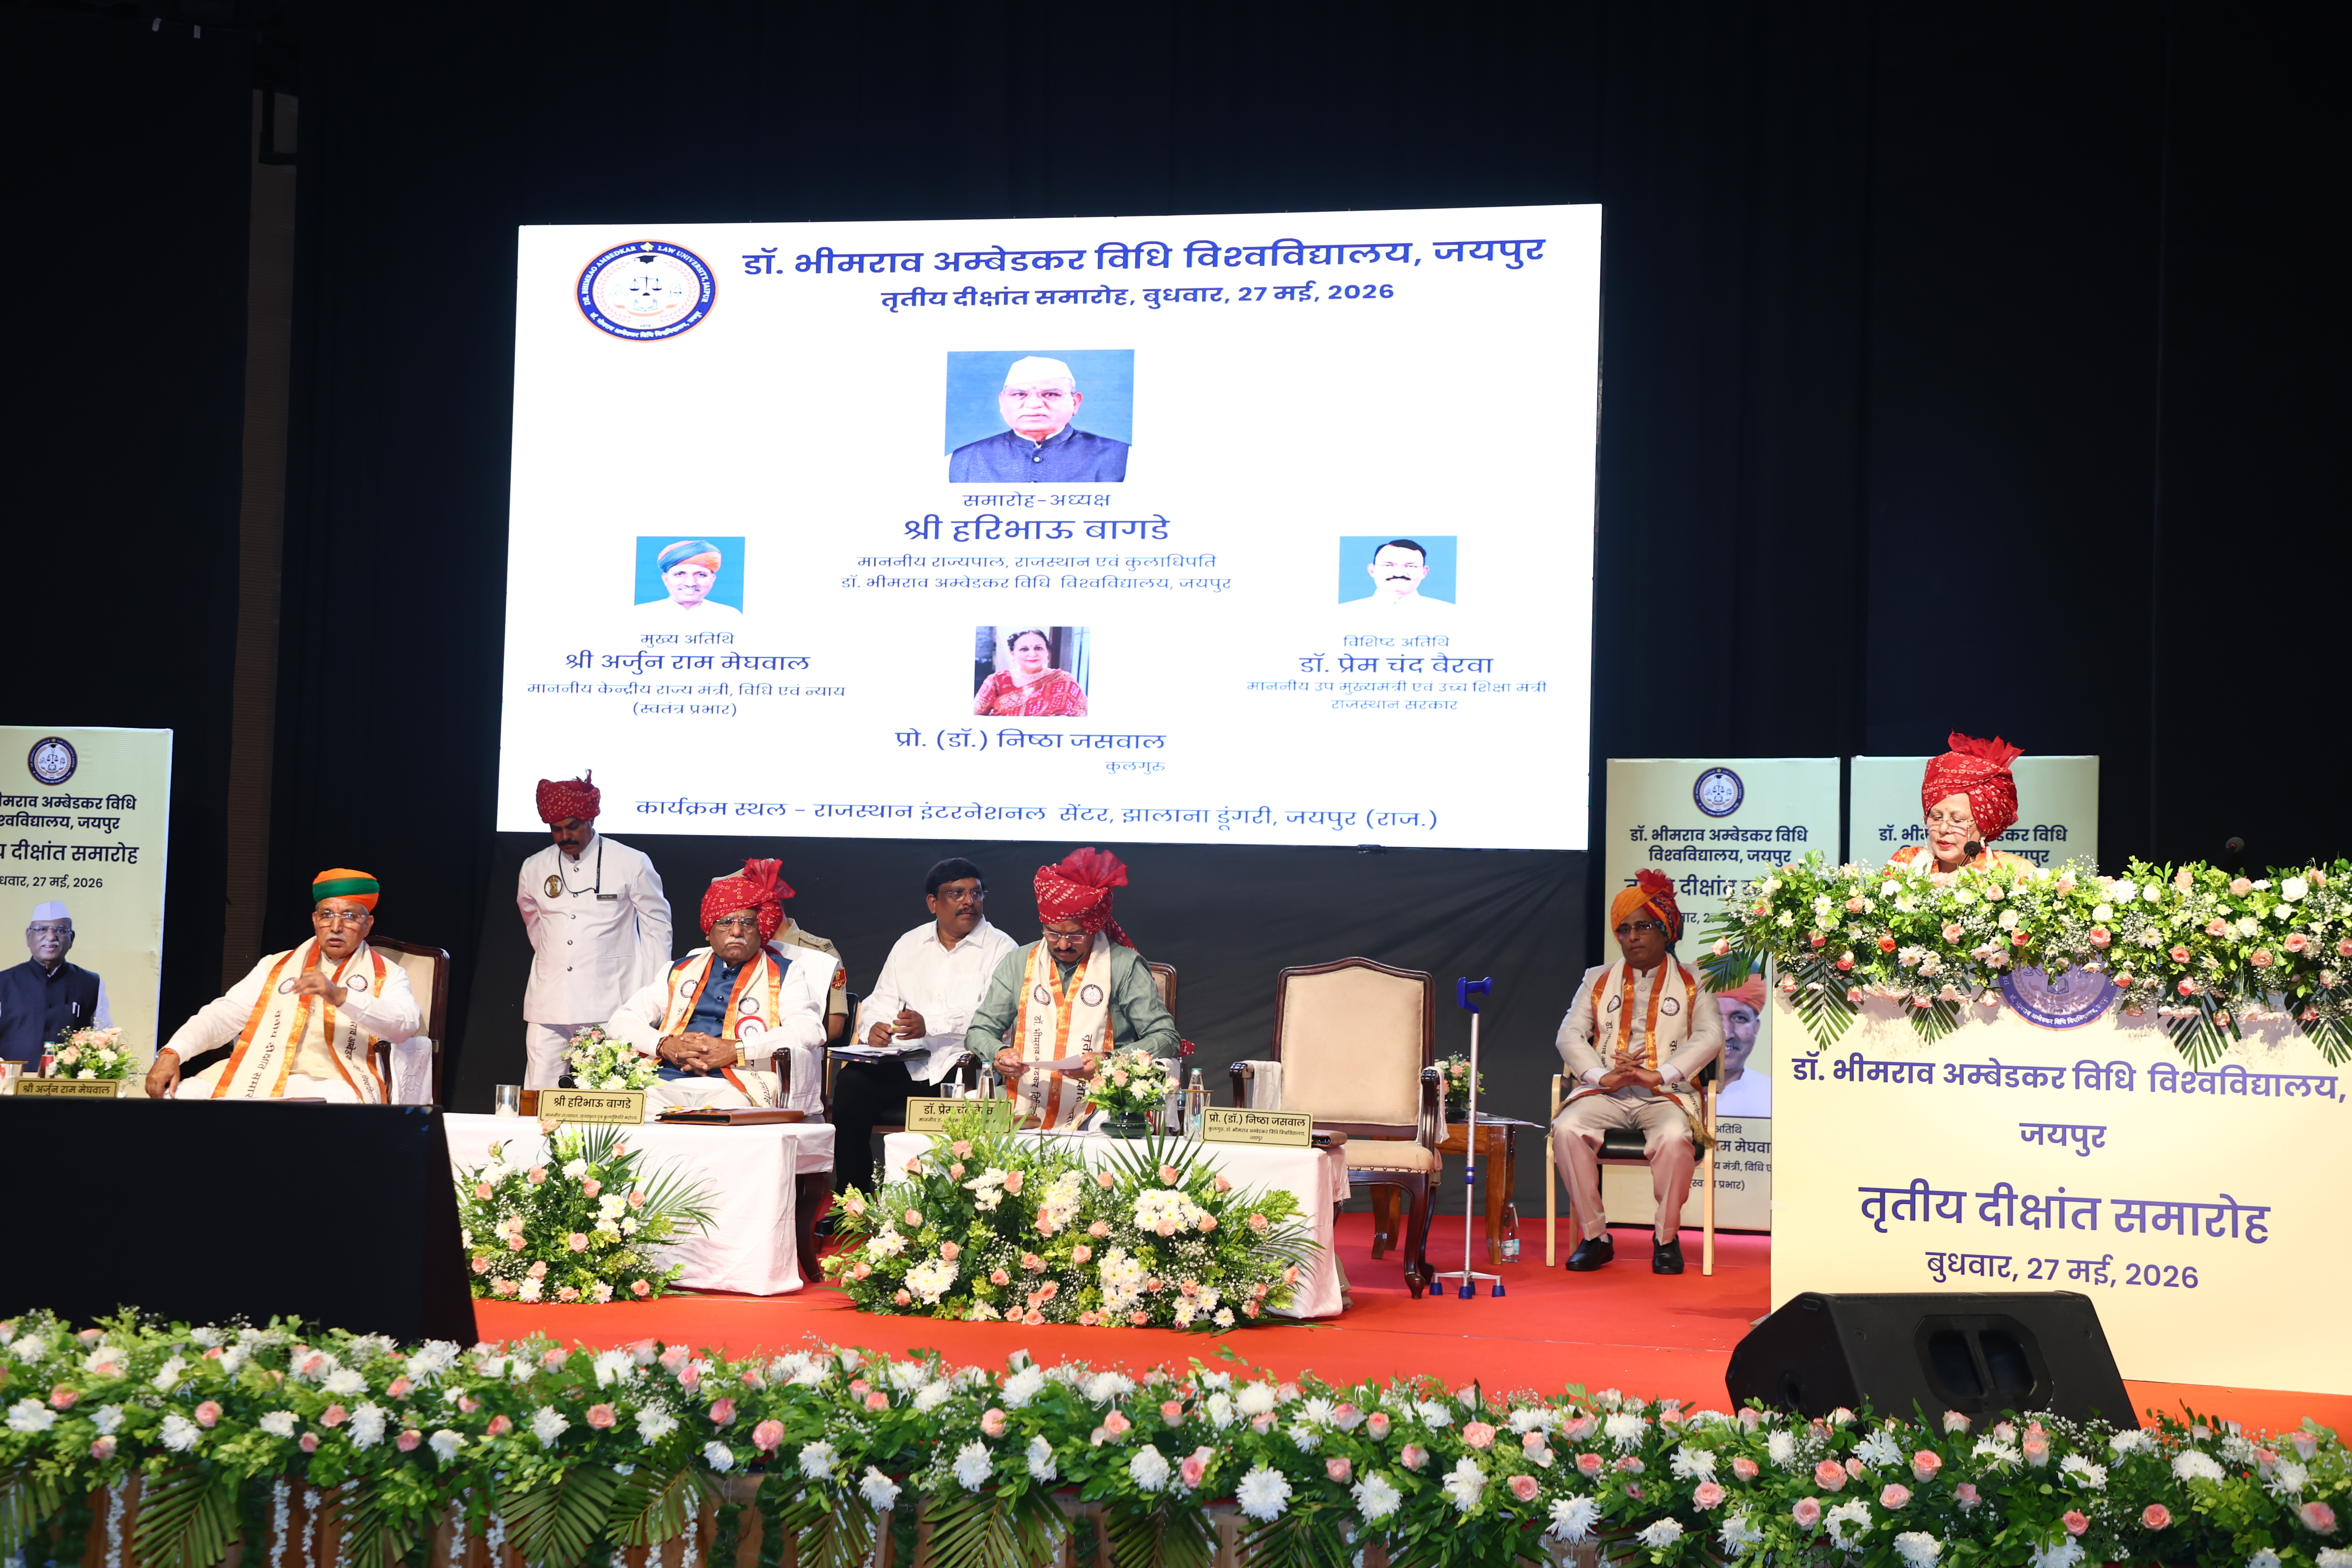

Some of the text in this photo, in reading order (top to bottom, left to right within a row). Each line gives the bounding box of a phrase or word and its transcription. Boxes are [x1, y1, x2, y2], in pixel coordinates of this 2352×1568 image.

[596, 246, 637, 267] AMBEDKAR
[742, 238, 1546, 275] डॉ. भीमराव अम्बेडकर विधि विश्वविद्यालय, जयपुर
[676, 250, 709, 282] UNIVERSITY,
[581, 266, 598, 294] BHIMRAO
[582, 295, 591, 306] DR.
[701, 282, 711, 303] JAIPUR
[880, 280, 1394, 313] तृतीय दीक्षांत समारोह, बुधवार, 27 मई, 2026
[962, 491, 1111, 508] समारोह-अध्यक्ष
[904, 514, 1171, 542] श्री हरिभाऊ बागडे
[858, 554, 1217, 572] माननीय राज्यपाल, राजस्थान एवं कुलाधिपति
[842, 574, 1231, 593] डॉ. भीमराव अम्बेडकर विधि विश्वविद्यालय, जयपुर
[641, 632, 734, 648] मुख्य अतिथि
[1343, 635, 1449, 647] विशिष्ट अतिथि
[566, 650, 811, 675] श्री अर्जुन राम मेघवाल
[1299, 652, 1494, 673] डॉ. प्रेम चंद बैरवा
[528, 681, 845, 697] माननीय केन्द्रीय राज्य मंत्री, विधि एवं न्याय
[1247, 679, 1546, 695] माननीय उप मुख्यमंत्री एवं उच्च शिक्षा मंत्री
[633, 702, 736, 717] (स्वतंत्र प्रभार)
[1331, 700, 1458, 710] राजस्थान सरकार
[895, 728, 1167, 751] प्रो. (डॉ.) निष्ठा जसवाल
[1106, 762, 1165, 775] कुलगुरु
[42, 793, 137, 810] अम्बेडकर विधि
[635, 797, 728, 815] कार्यक्रम
[734, 803, 788, 816] स्थल
[813, 804, 914, 818] राजस्थान
[920, 802, 1047, 820] इंटरनेशनल
[1059, 803, 1113, 824] सेंटर,
[1122, 809, 1210, 823] झालाना
[1216, 806, 1277, 831] डूंगरी,
[1286, 811, 1357, 831] जयपुर
[1367, 809, 1437, 830] (राज.)
[77, 817, 120, 834] जयपुर
[1630, 825, 1808, 842] डॉ. भीमराव अम्बेडकर विधि
[1878, 824, 2068, 842] डॉ. विधि
[10, 838, 67, 861] दीक्षांत
[71, 842, 140, 864] समारोह
[1648, 845, 1792, 867] विश्वविद्यालय, जयपुर
[33, 874, 103, 889] 27 मई, 2026
[1791, 1051, 2346, 1103] डॉ. भीमराव अम्बेडकर विधि विश्वविद्यालय,
[23, 1083, 34, 1093] श्री
[35, 1083, 58, 1096] अर्जुन
[78, 1083, 111, 1094] मेघवाल
[554, 1095, 632, 1109] श्री हरिभाऊ बागडे
[924, 1103, 935, 1114] डॉ.
[1209, 1112, 1306, 1126] प्रो. (डॉ.) निष्ठा जसवाल
[1734, 1138, 1771, 1153] मेघवा
[2019, 1123, 2107, 1157] जयपुर
[1858, 1178, 2271, 1244] तृतीय दीक्षांत समारोह
[1925, 1252, 2198, 1289] बुधवार, 27 मई, 2026
